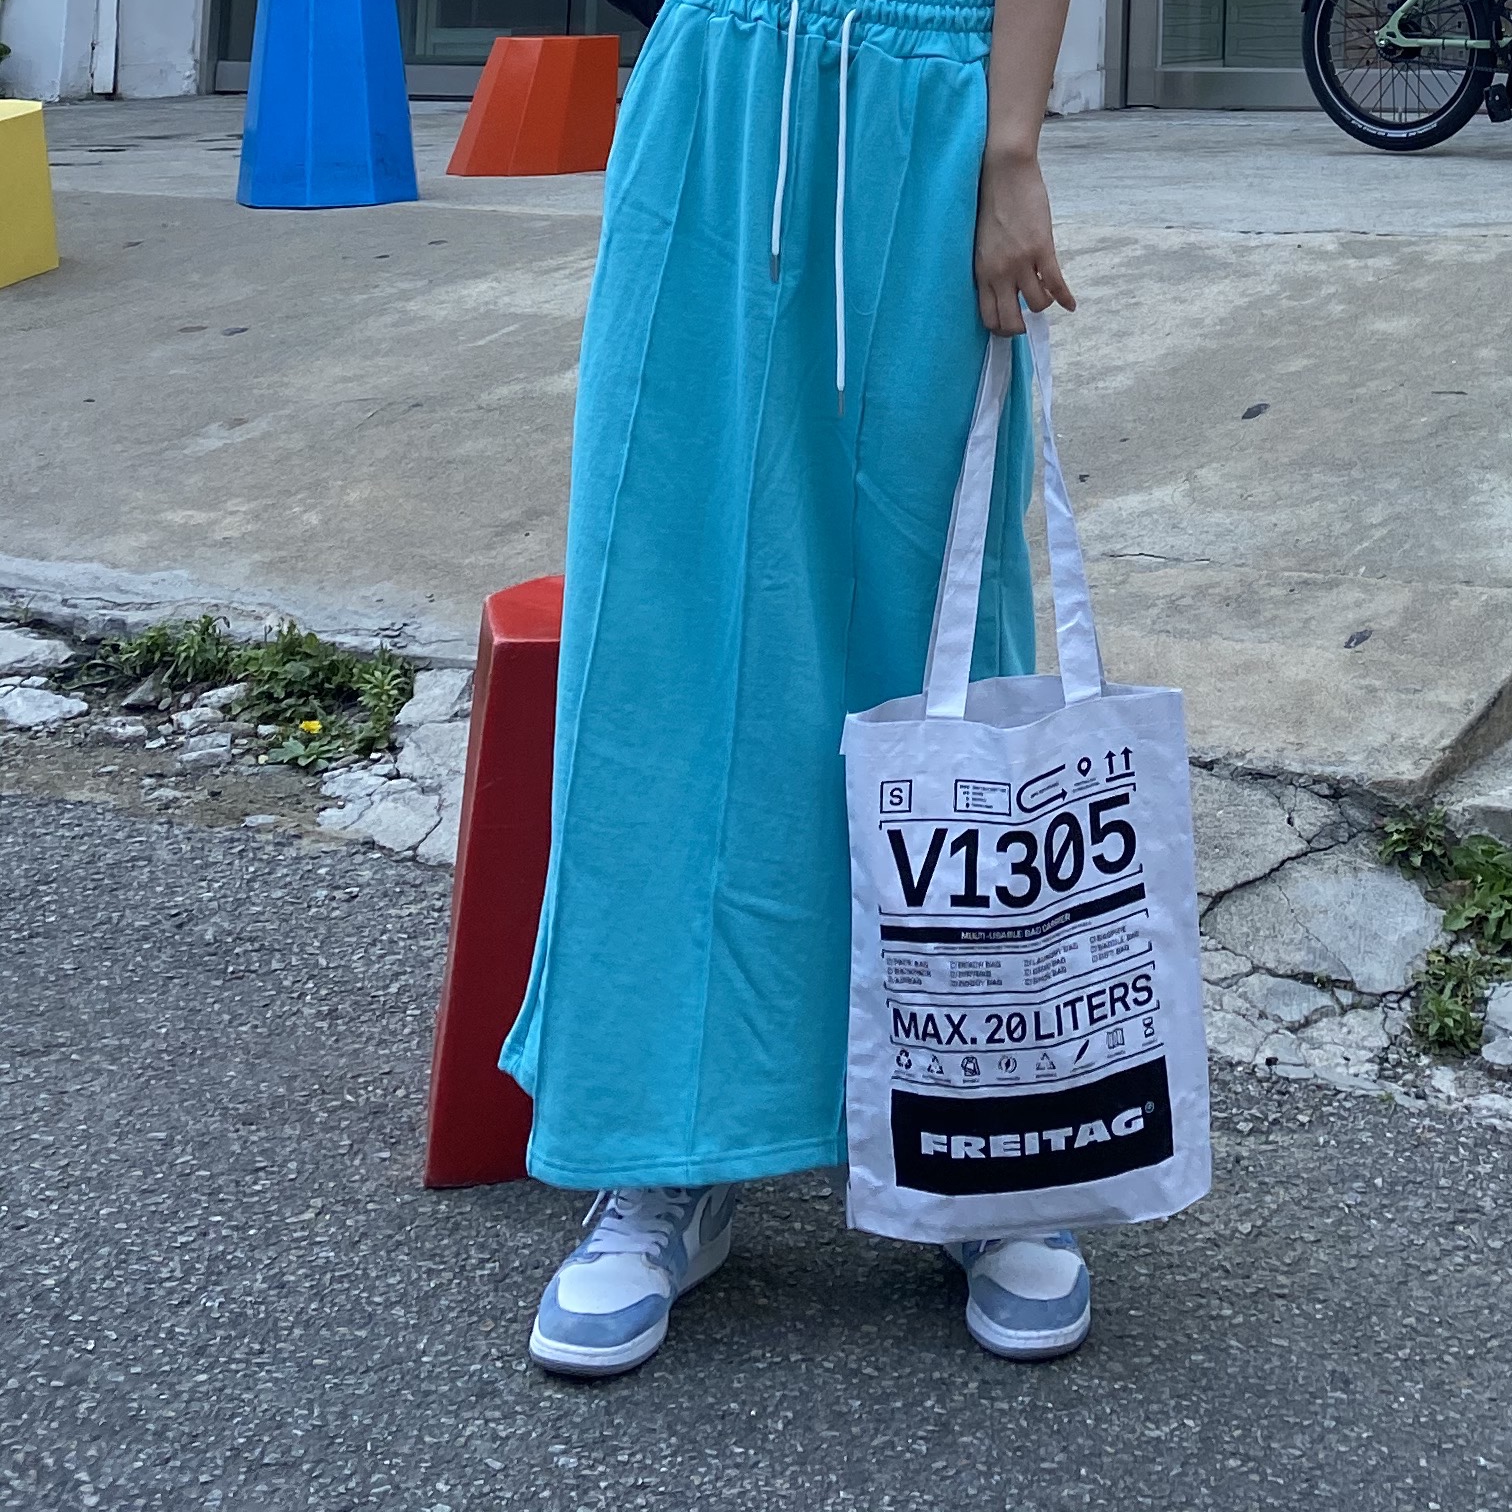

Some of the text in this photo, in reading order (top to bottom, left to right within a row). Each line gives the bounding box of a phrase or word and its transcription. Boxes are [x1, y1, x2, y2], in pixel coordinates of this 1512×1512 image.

[889, 787, 904, 806] S
[886, 792, 1137, 909] V1305
[892, 973, 1154, 1046] MAX. 20 LITERS
[920, 1106, 1145, 1159] FREITAG
